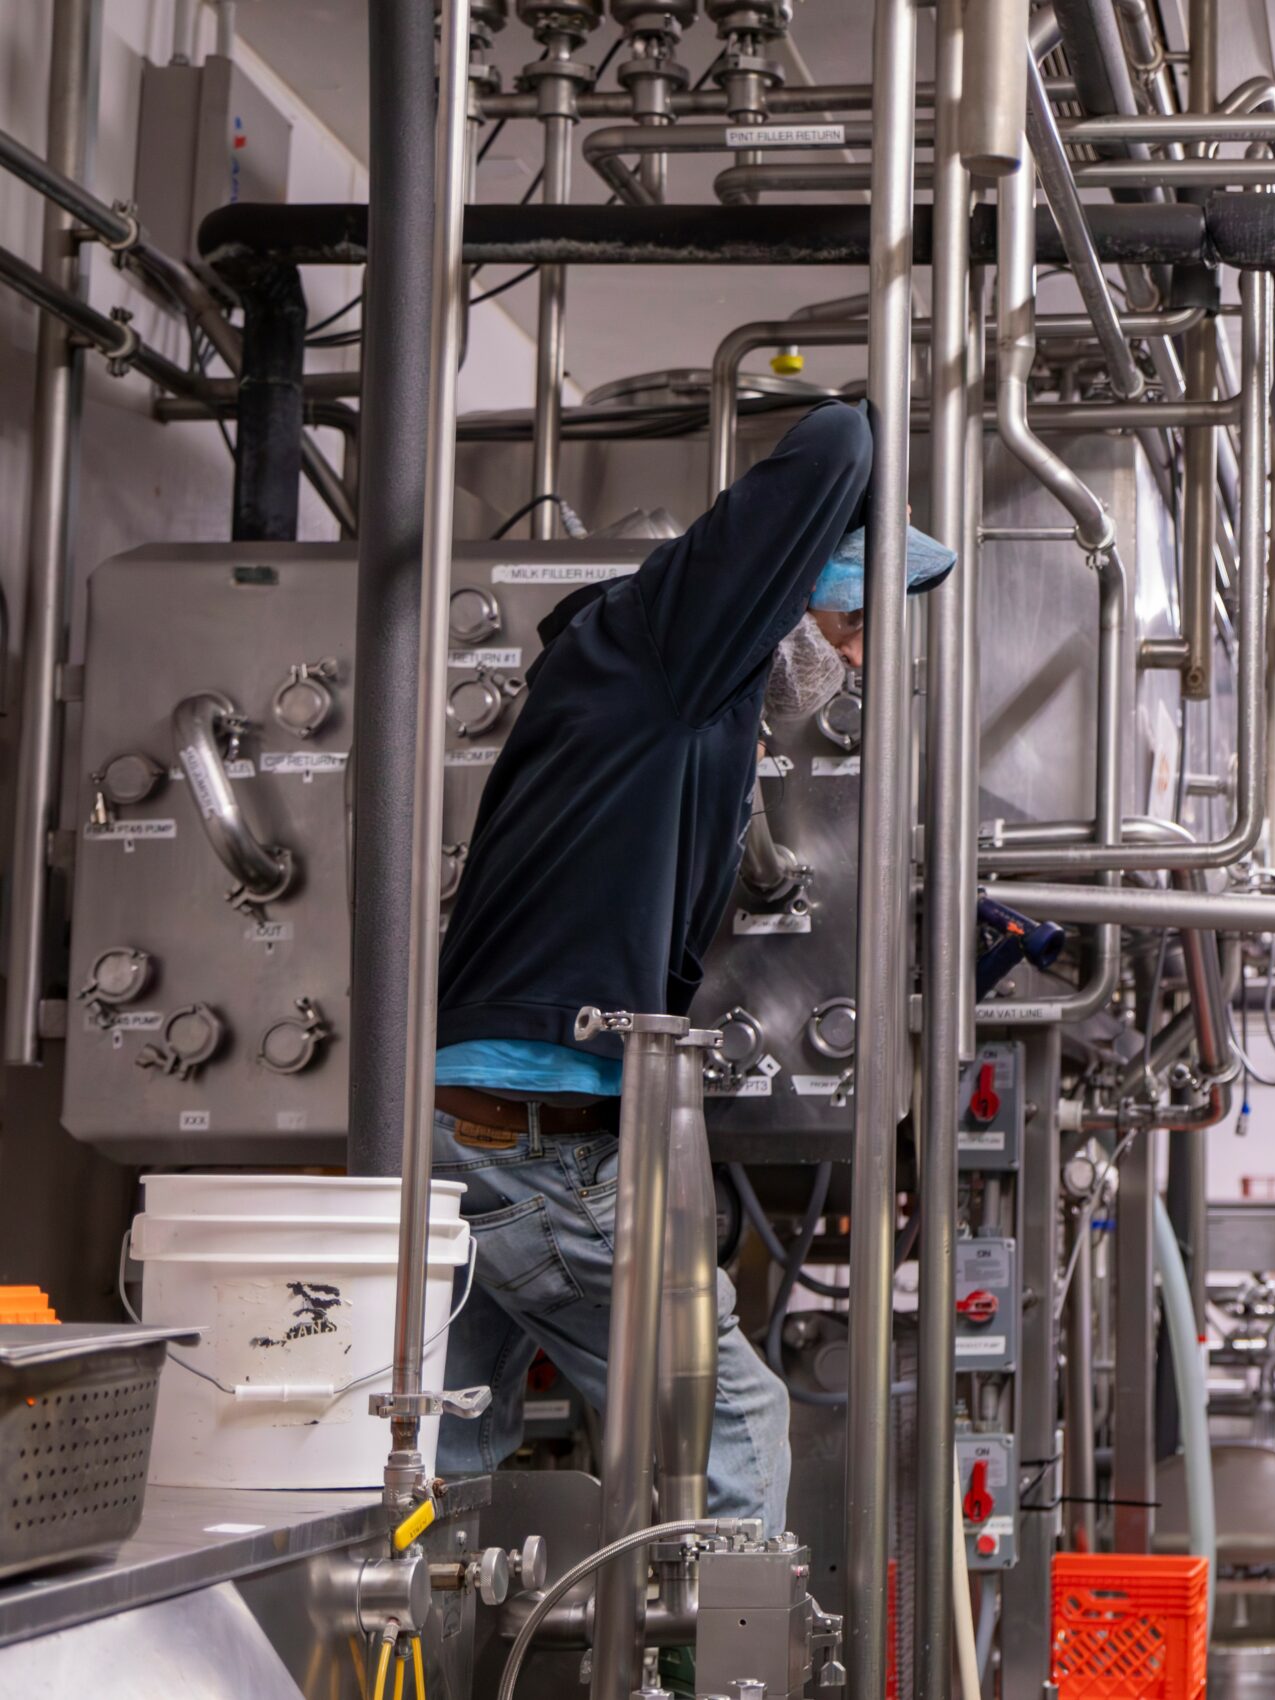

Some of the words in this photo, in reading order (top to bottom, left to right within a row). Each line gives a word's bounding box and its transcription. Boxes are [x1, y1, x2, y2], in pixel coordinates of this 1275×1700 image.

[730, 132, 754, 141] PINT
[757, 131, 793, 141] FILLER
[796, 130, 841, 140] RETURN
[511, 568, 538, 579] MILK
[542, 568, 582, 579] FILLER
[997, 1009, 1016, 1018] VAT
[1019, 1008, 1043, 1018] LINE
[975, 1447, 990, 1456] ON
